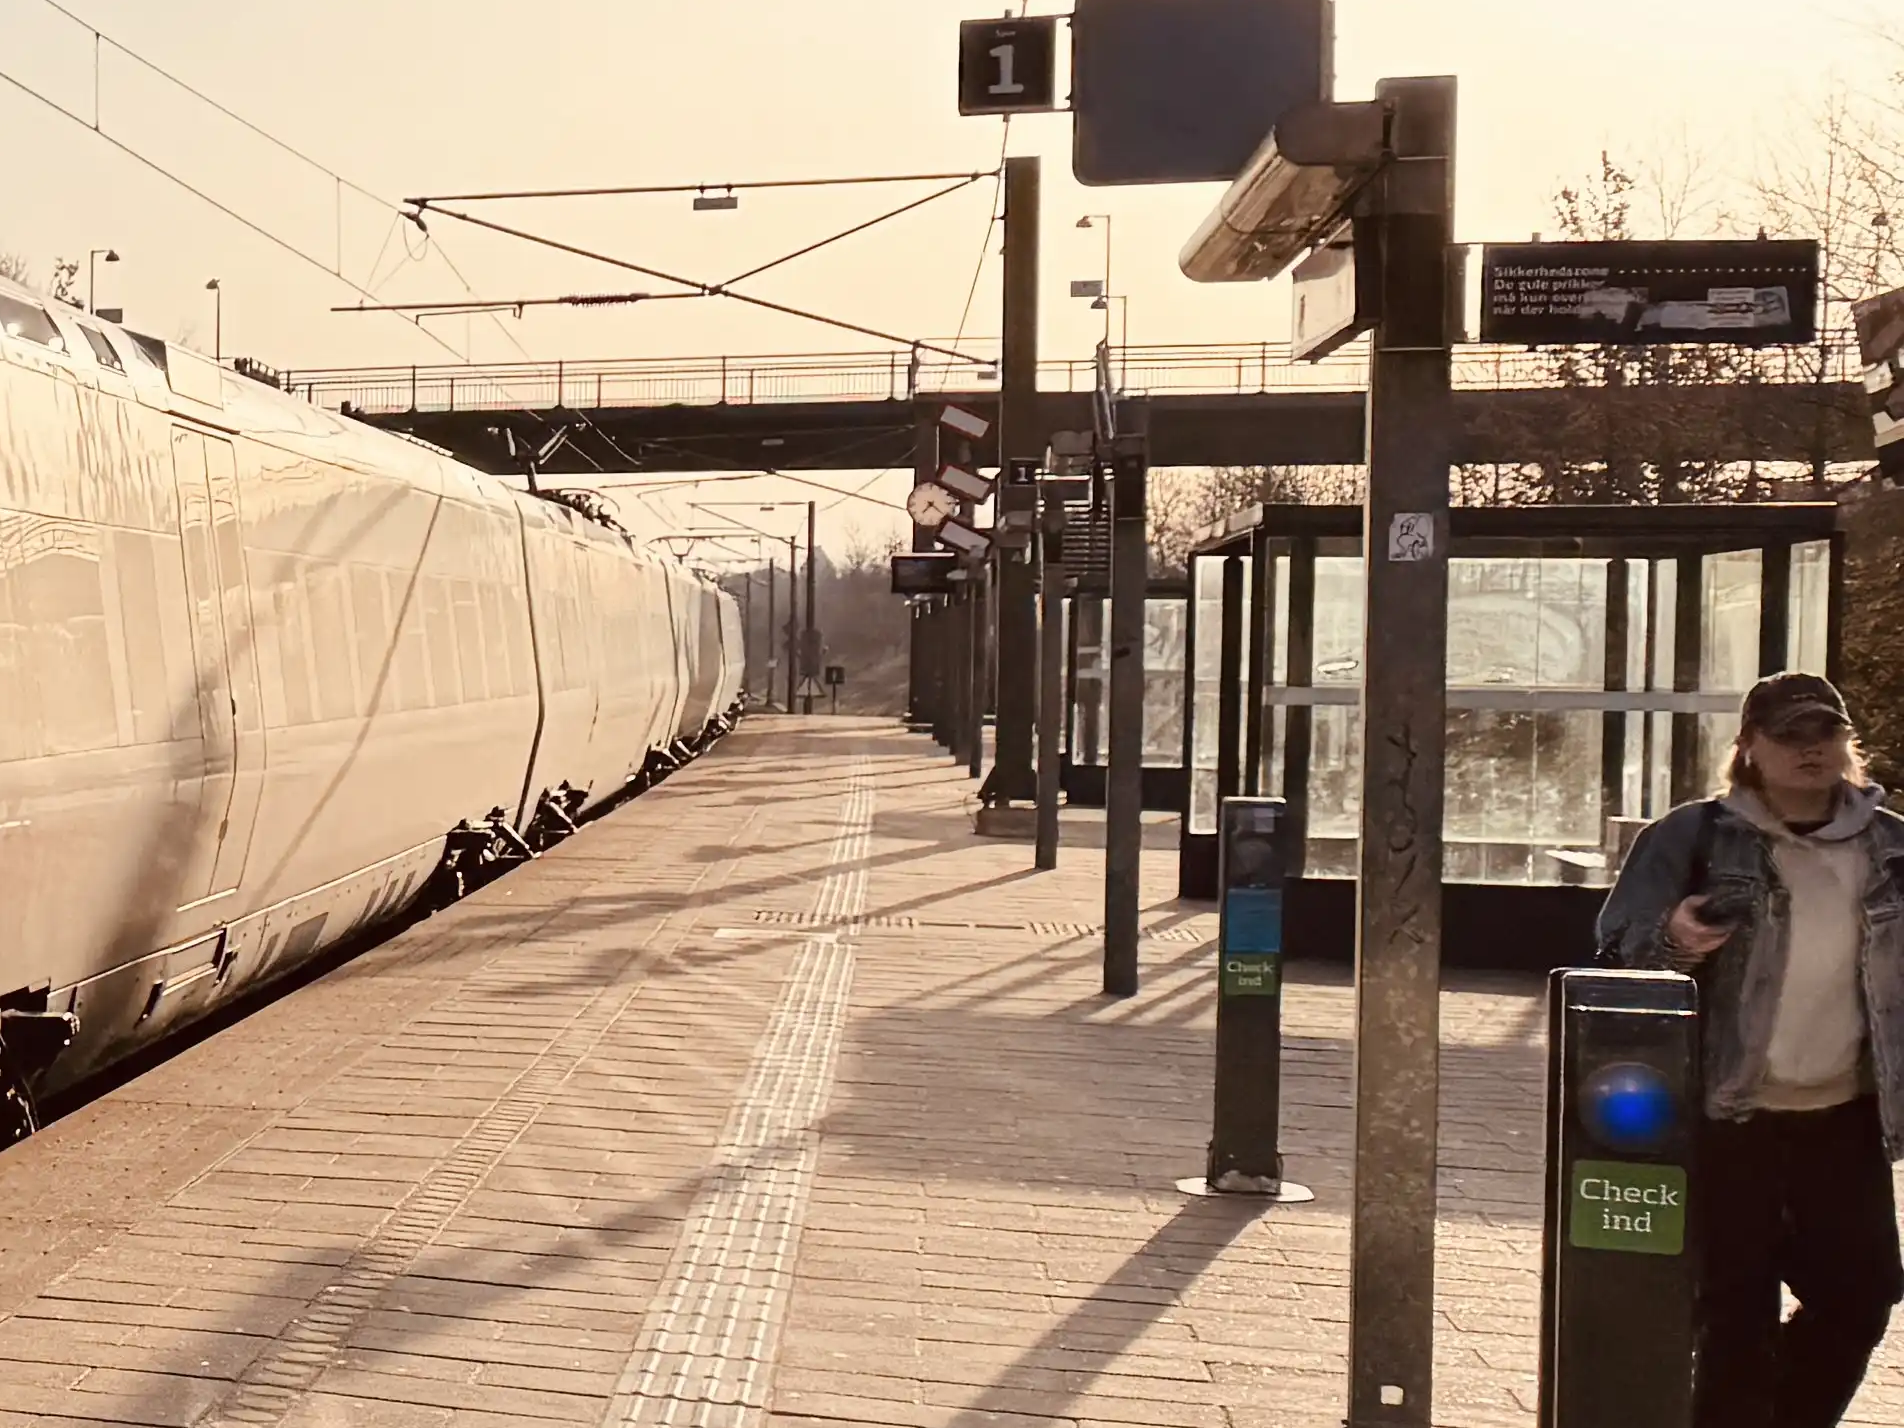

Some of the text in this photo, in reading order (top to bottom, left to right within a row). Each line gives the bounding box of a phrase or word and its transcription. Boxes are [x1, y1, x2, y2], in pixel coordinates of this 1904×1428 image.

[988, 44, 1024, 94] 1
[1016, 466, 1029, 483] 1
[1227, 960, 1277, 975] Check
[1580, 1178, 1680, 1207] Check
[1602, 1208, 1653, 1233] ind
